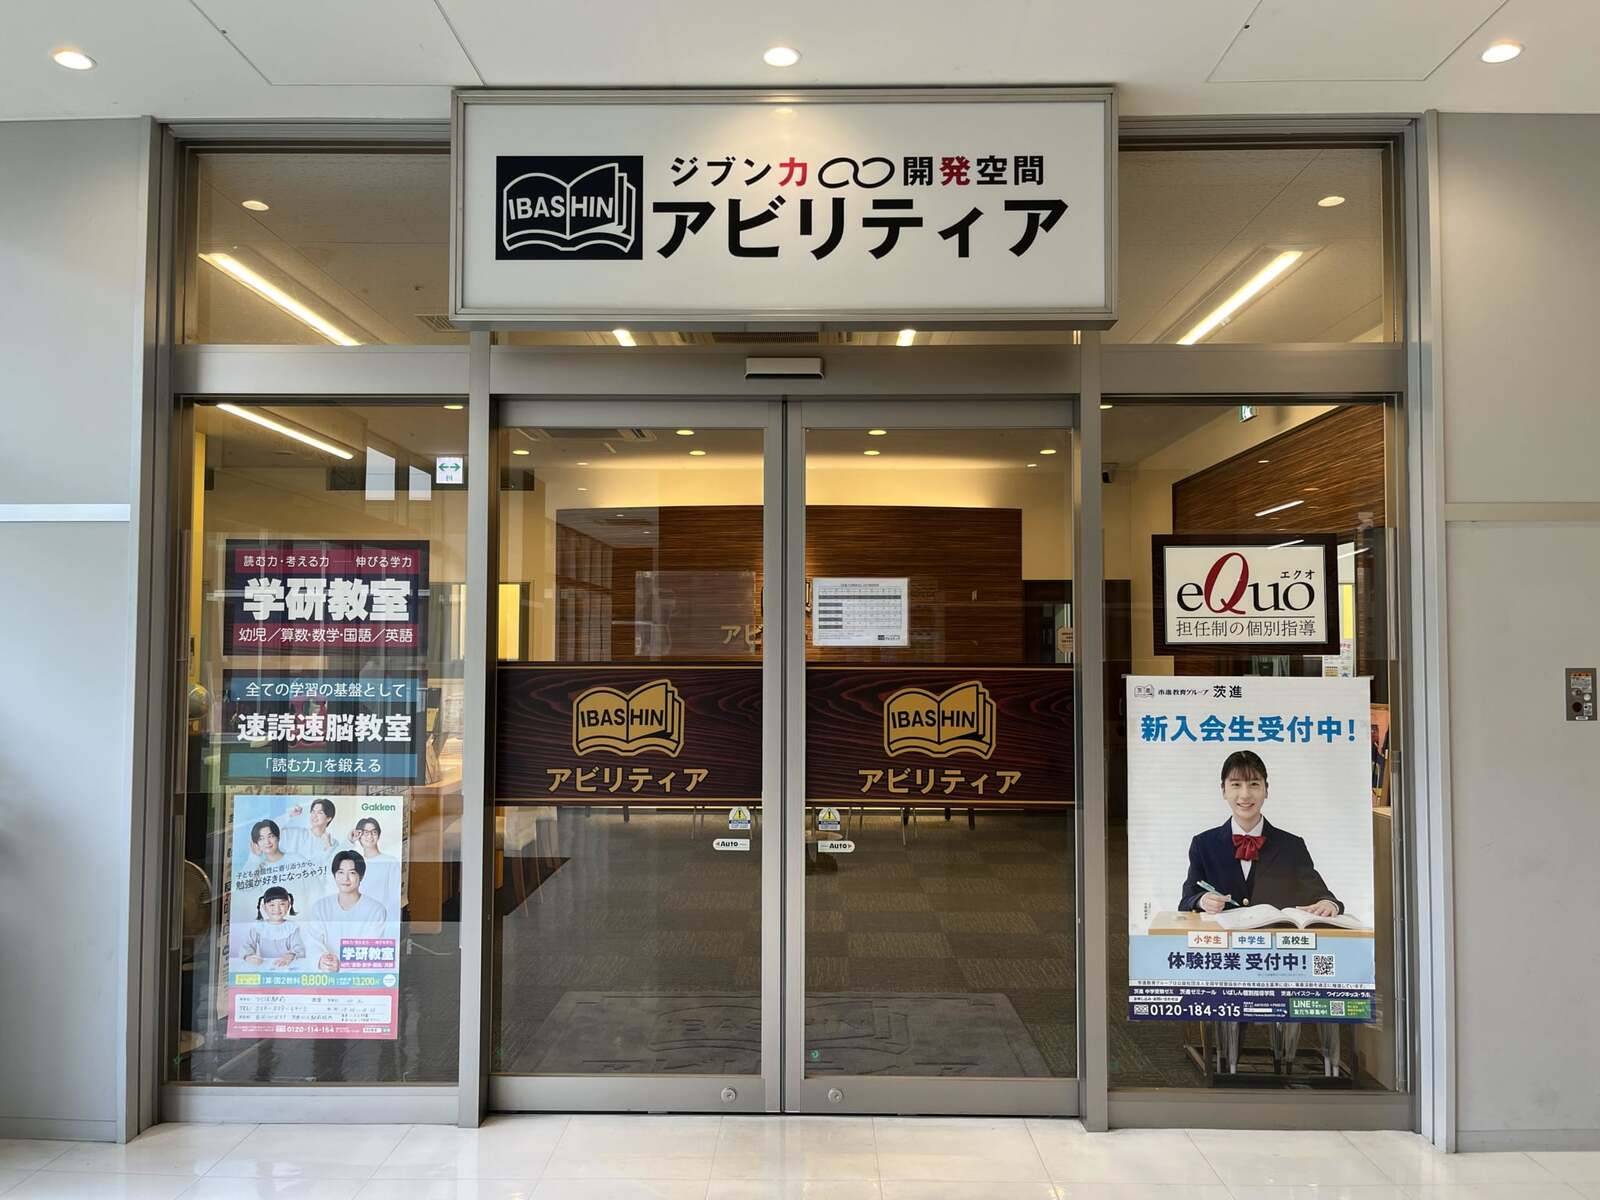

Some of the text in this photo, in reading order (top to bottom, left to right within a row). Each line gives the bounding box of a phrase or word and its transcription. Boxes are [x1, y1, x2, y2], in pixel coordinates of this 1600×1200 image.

[670, 156, 1044, 187] ジブン力 開発空間
[507, 194, 614, 222] IBASHIN
[652, 196, 1069, 260] アビリティア
[356, 555, 412, 569] 伸びる学力
[1280, 569, 1315, 580] エクオ
[1176, 552, 1315, 615] eQuo
[243, 577, 411, 622] 学研教室
[1176, 620, 1316, 637] 担任制の個別指導
[245, 682, 406, 698] 全ての学習の基盤として
[1212, 685, 1242, 698] 茨進
[580, 708, 664, 728] IBASHIN
[891, 709, 975, 729] IBASHIN
[237, 713, 412, 743] 速読速脳教室
[1140, 714, 1356, 743] 新入会生受付中!
[265, 758, 382, 774] 「読む力」を鍛える
[546, 766, 709, 793] アビリティア
[858, 767, 1022, 795] アビリティア
[361, 802, 396, 812] Gakken
[1193, 935, 1222, 945] 小学生
[1238, 935, 1265, 945] 中学生
[1281, 935, 1310, 945] 高校生
[342, 946, 394, 960] 学研教室
[1167, 952, 1307, 971] 体験授業 受付中!
[1150, 1004, 1241, 1017] 0120-184-315
[1293, 1000, 1311, 1008] LINE
